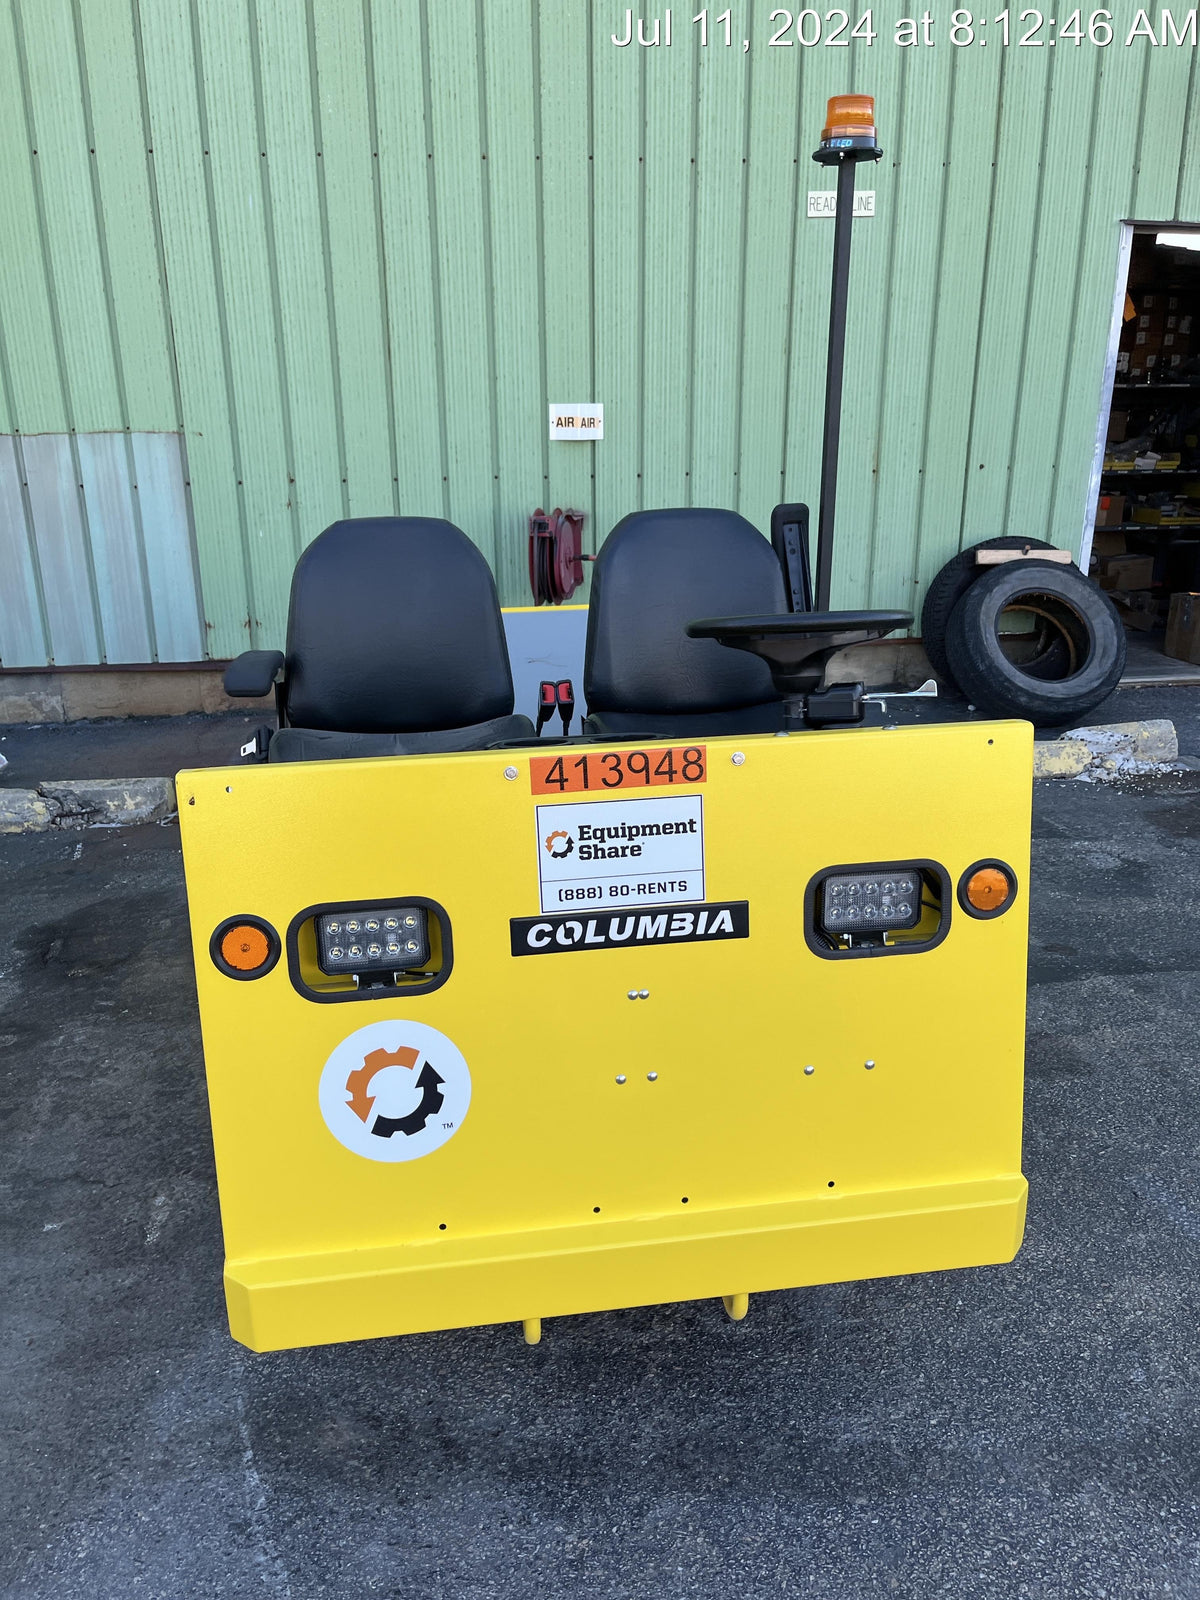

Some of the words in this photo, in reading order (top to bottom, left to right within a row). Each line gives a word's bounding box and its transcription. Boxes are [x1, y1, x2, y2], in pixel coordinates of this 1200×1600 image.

[809, 196, 837, 211] READ
[556, 416, 575, 428] AIR
[581, 417, 596, 428] AIR
[544, 747, 704, 791] 413948
[578, 818, 697, 843] Equipment
[578, 843, 642, 861] Share
[558, 885, 603, 902] (888)
[608, 880, 688, 898] 80-RENTS
[526, 909, 735, 948] COLUMBIA
[442, 1122, 454, 1130] TM
